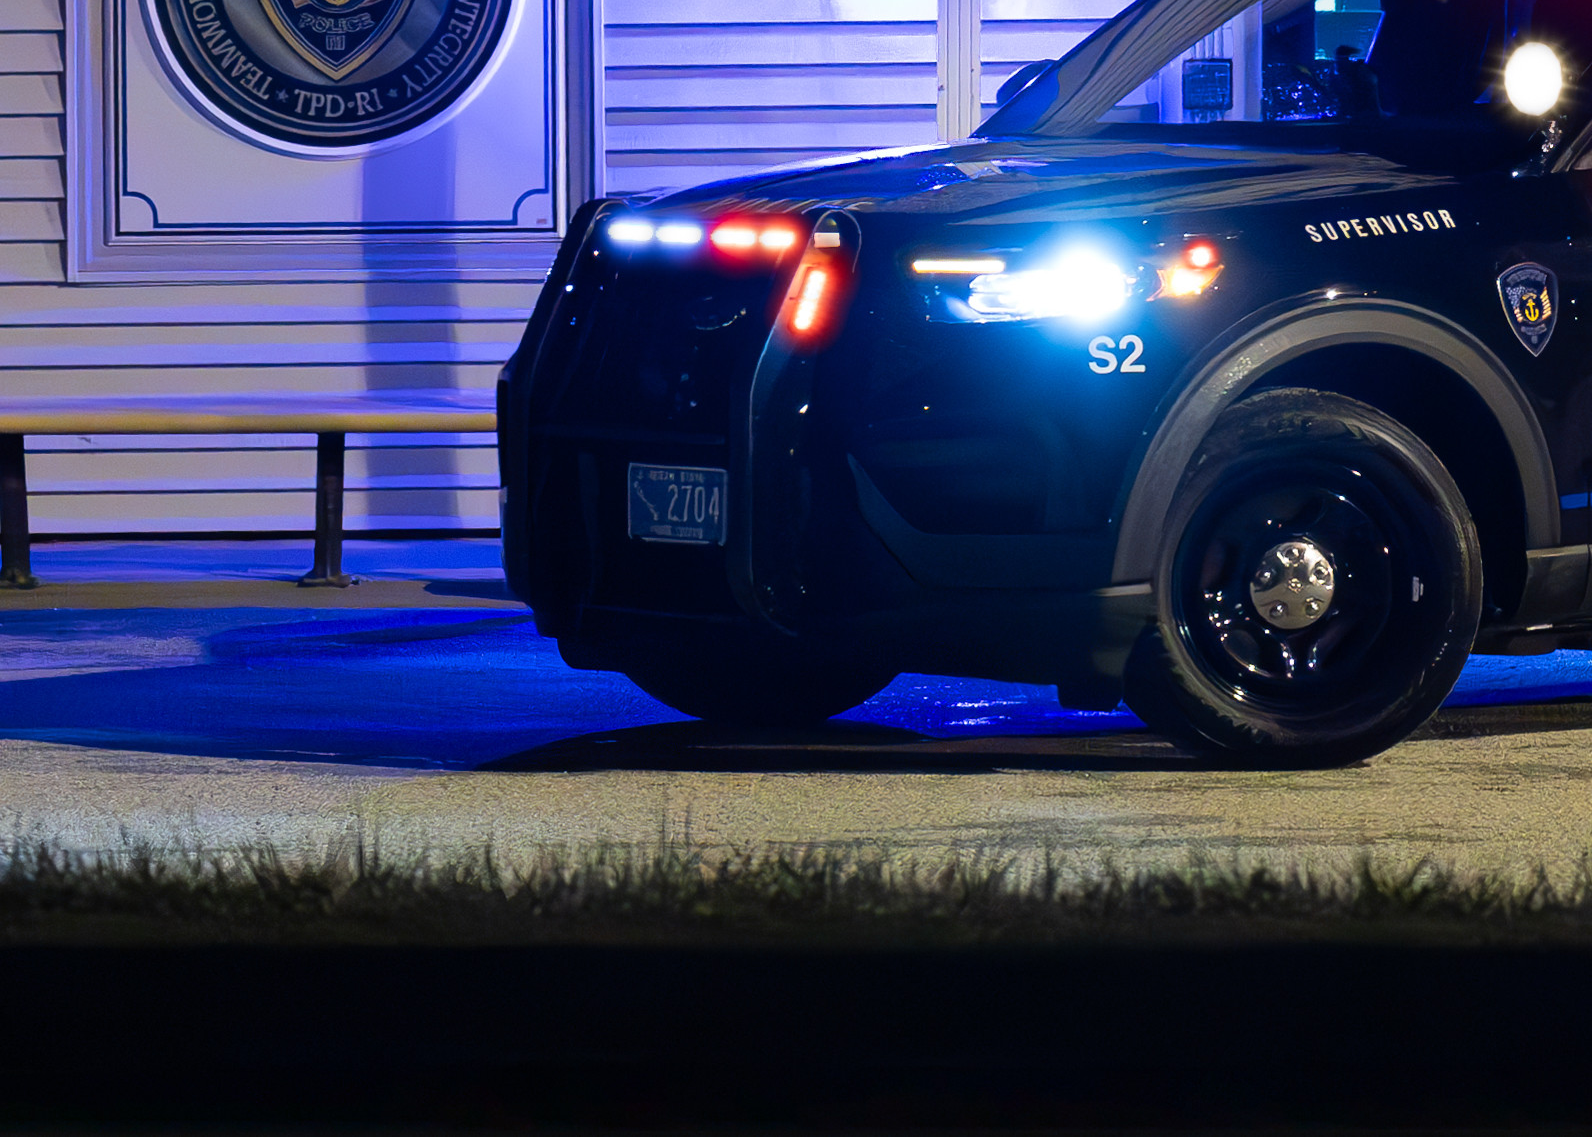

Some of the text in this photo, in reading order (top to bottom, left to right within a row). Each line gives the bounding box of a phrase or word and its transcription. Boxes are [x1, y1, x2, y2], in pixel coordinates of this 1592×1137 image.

[1304, 208, 1457, 244] SUPERVISOR
[1087, 334, 1147, 375] S2
[668, 484, 720, 524] 2704
